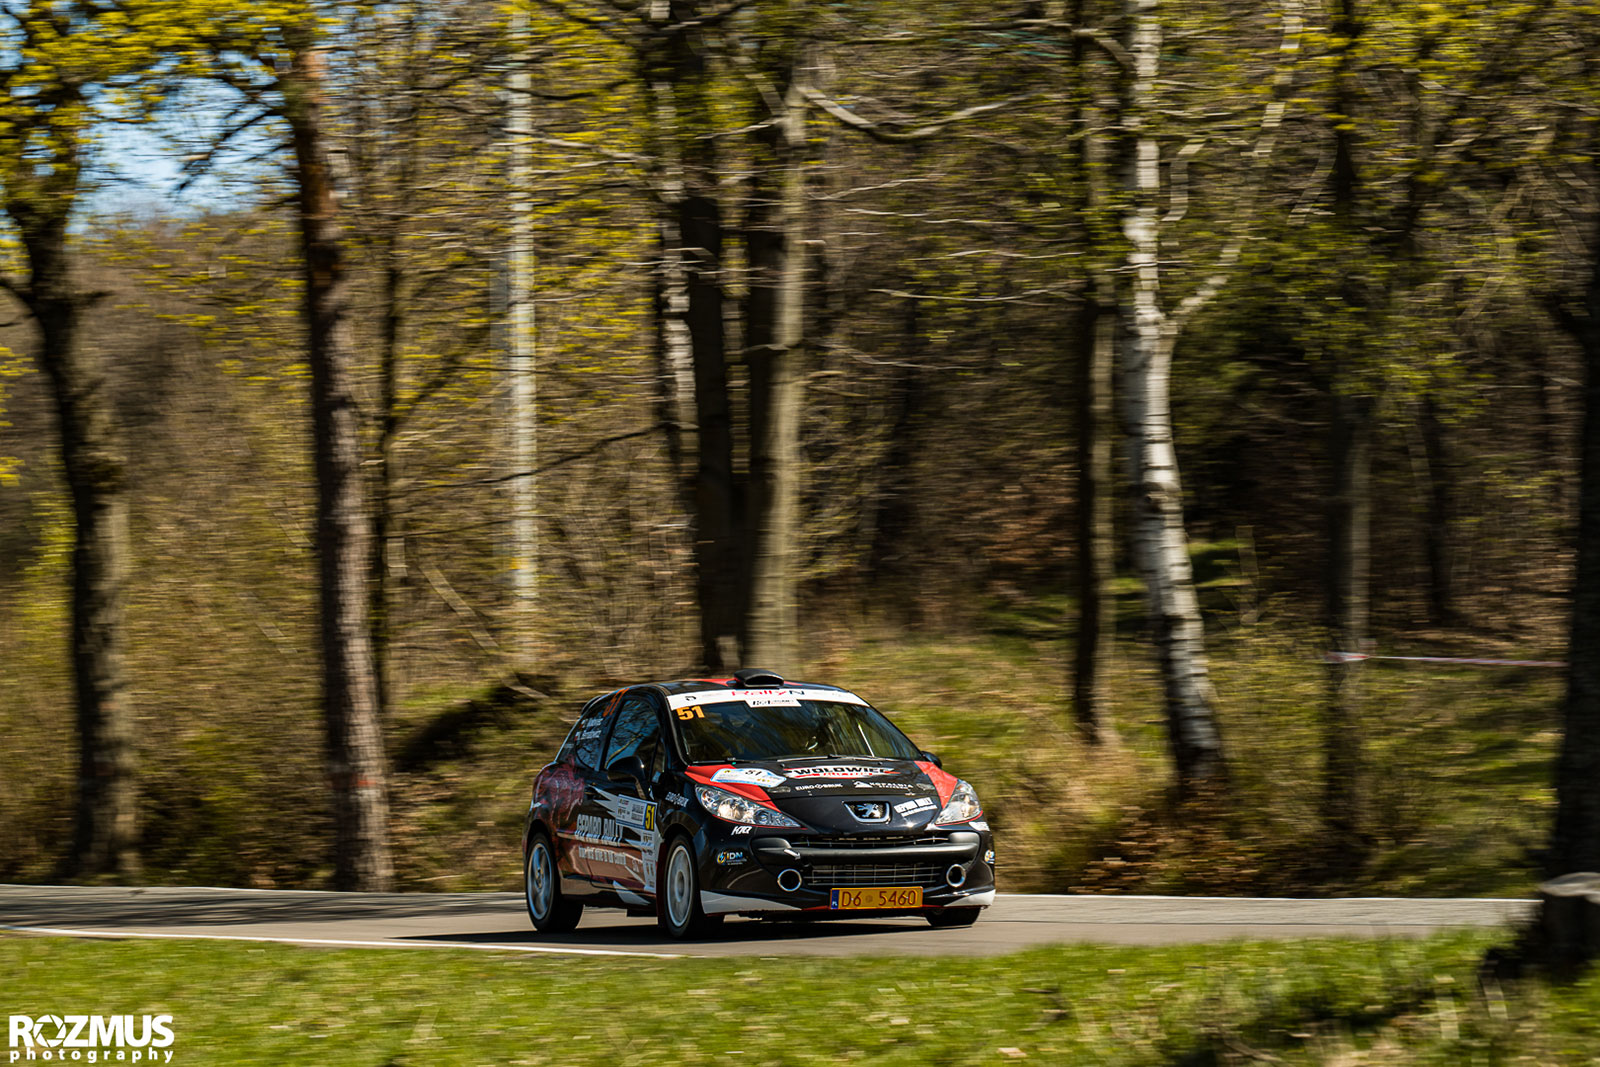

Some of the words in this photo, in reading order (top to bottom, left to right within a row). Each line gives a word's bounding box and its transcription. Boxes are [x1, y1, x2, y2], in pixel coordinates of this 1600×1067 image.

[676, 706, 704, 720] 51
[645, 805, 655, 830] 51
[727, 852, 743, 860] IDN
[842, 891, 861, 907] D6
[879, 890, 917, 906] 5460
